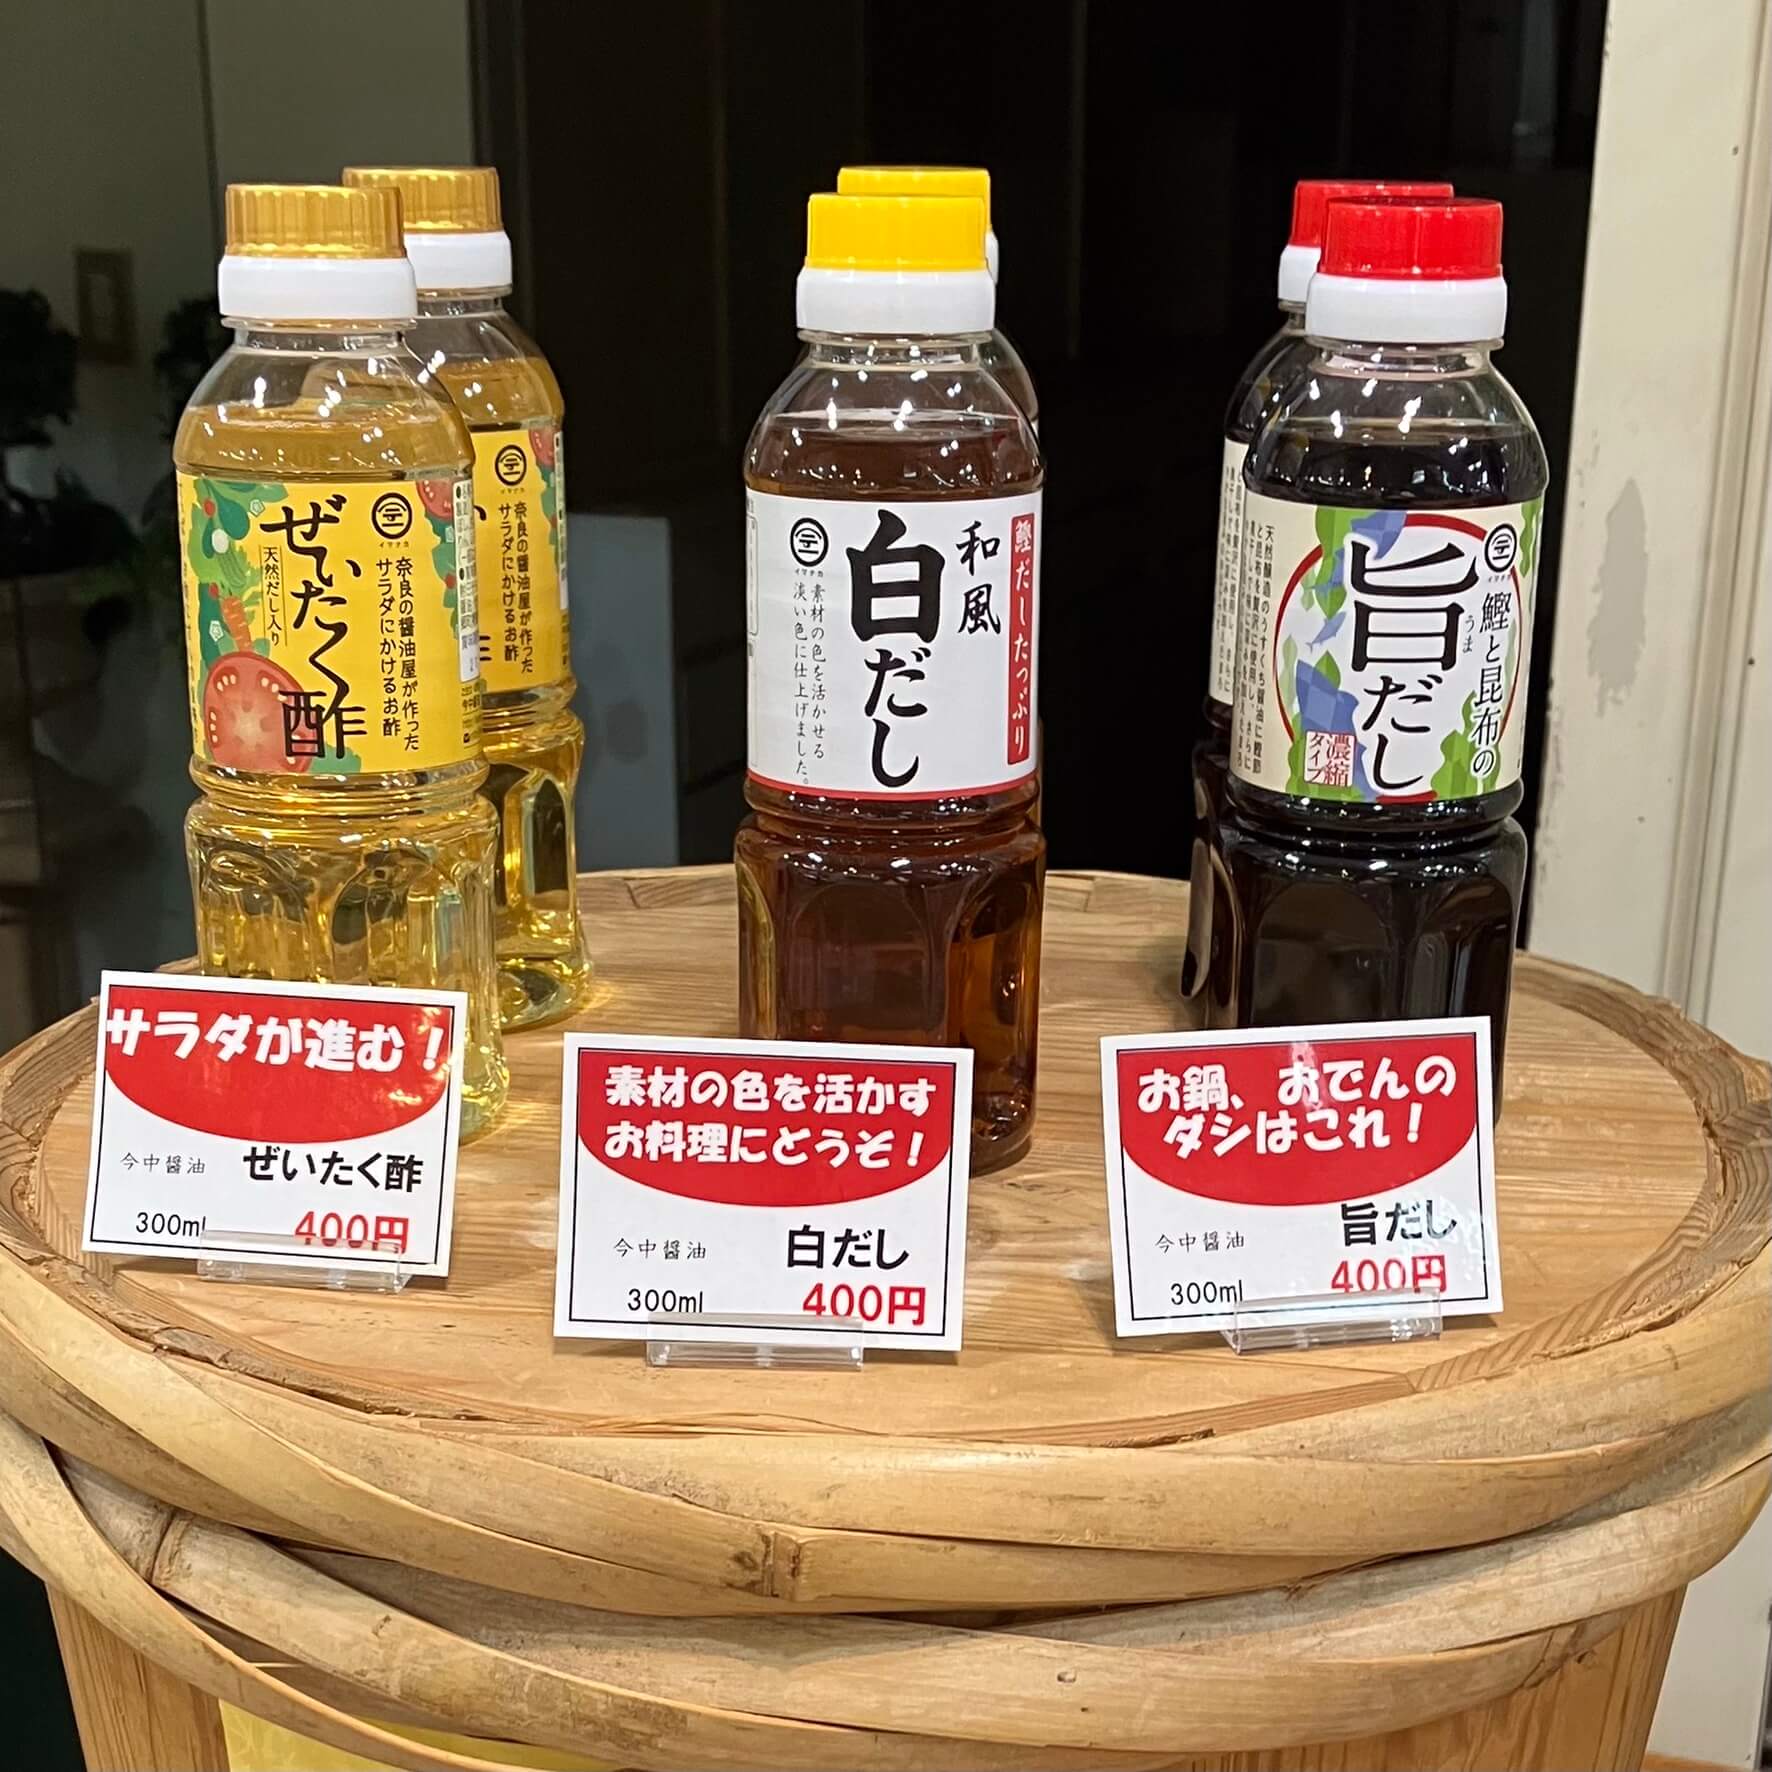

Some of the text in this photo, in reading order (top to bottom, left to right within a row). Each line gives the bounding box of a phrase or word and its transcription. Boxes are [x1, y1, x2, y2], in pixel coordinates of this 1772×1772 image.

[263, 546, 283, 646] 天然だし入り
[499, 503, 519, 661] サラダにかけるお酢
[955, 520, 1002, 635] 和風
[260, 494, 367, 760] ぜいたく酢
[375, 558, 402, 737] サラダにかけるお酢
[846, 509, 946, 789] 白だし
[1463, 615, 1476, 654] うま
[810, 583, 827, 759] 素材の色を活かせる
[1350, 541, 1479, 789] 旨だし
[1470, 592, 1512, 775] 鰹と昆布の
[107, 1008, 445, 1073] サラダが進む！
[605, 1065, 937, 1117] 素材の色を活かす
[605, 1120, 924, 1169] お料理にどうぞ！
[1164, 1102, 1423, 1159] ダシはこれ！
[243, 1145, 424, 1193] ぜいたく酢
[136, 1212, 206, 1237] 300ml
[294, 1211, 409, 1254] 400円
[787, 1224, 910, 1270] 白だし
[1341, 1199, 1458, 1246] 旨だし
[1171, 1280, 1244, 1305] 300ml
[1331, 1255, 1447, 1293] 400円
[627, 1288, 703, 1313] 300ml
[802, 1283, 927, 1326] 400円
